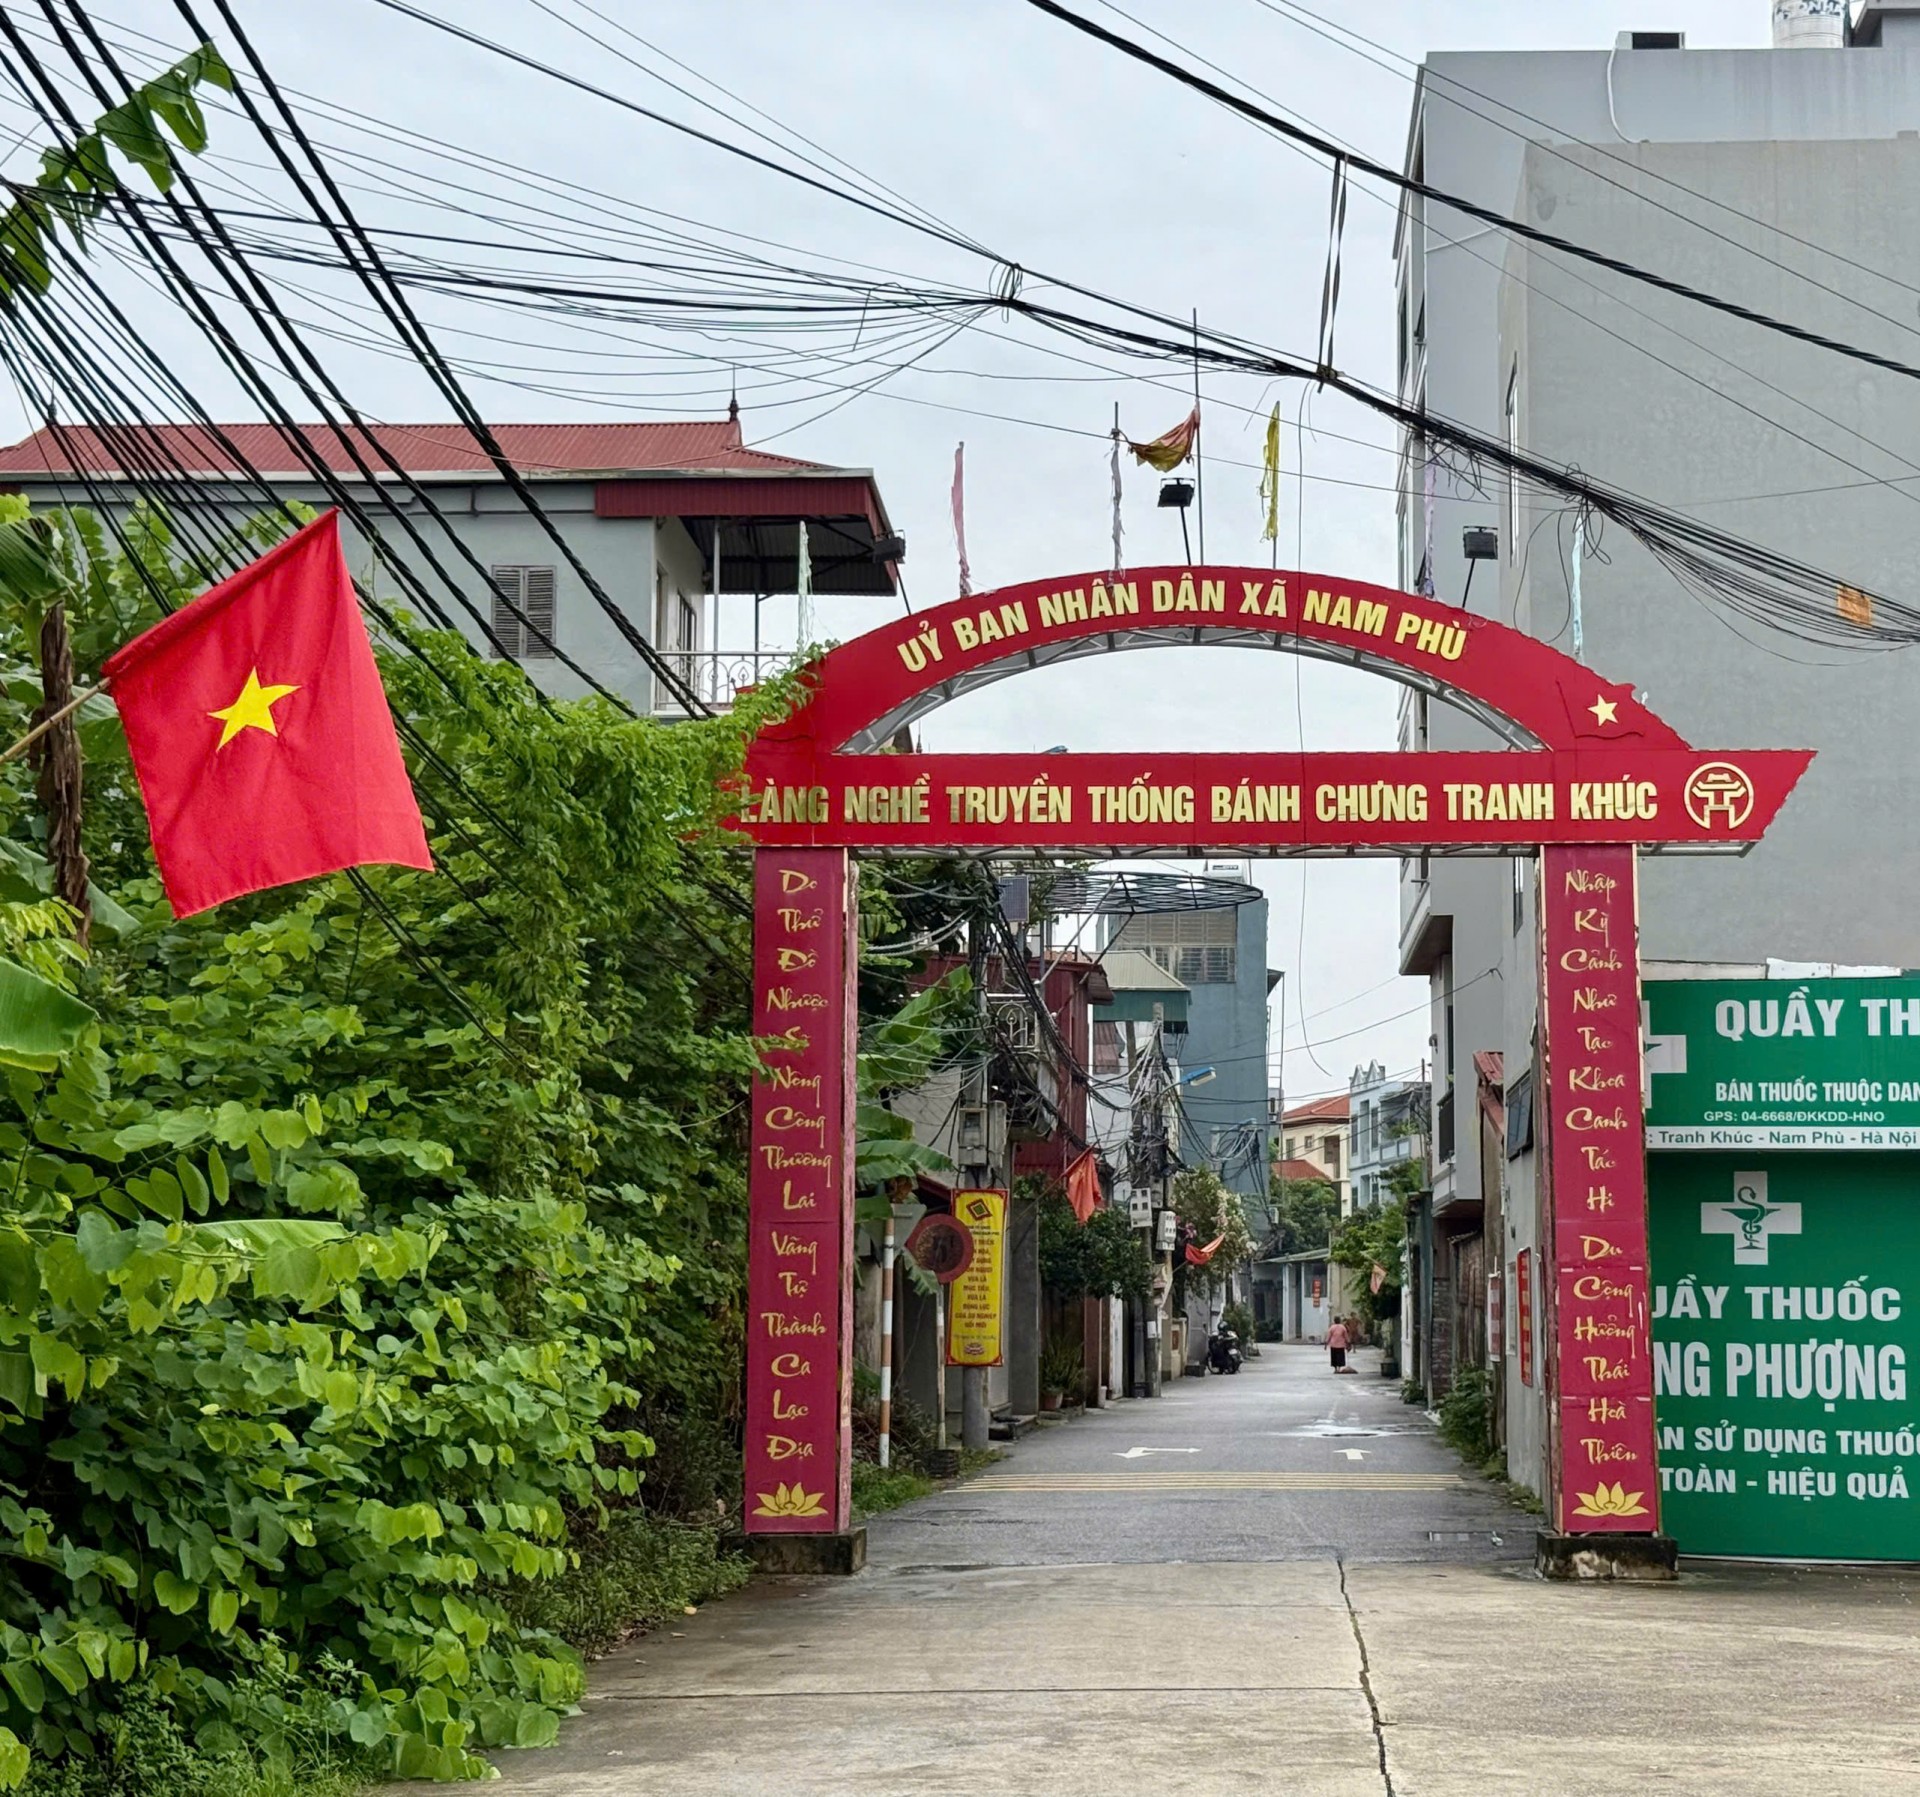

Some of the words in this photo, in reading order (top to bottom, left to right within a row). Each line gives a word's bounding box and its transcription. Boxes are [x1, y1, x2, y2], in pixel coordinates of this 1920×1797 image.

[898, 619, 944, 673] UỶ
[952, 600, 1029, 652] BAN
[1037, 581, 1140, 629] NHÂN
[1151, 574, 1227, 614] DÂN
[1238, 579, 1288, 619] XÃ
[1303, 590, 1389, 635] NAM
[1394, 612, 1468, 662] PHÙ
[843, 772, 931, 824] NGHỀ
[945, 771, 1073, 825] TRUYỀN
[1088, 771, 1195, 825] THỐNG
[1210, 776, 1301, 824] BÁNH
[1314, 780, 1429, 824] CHƯNG
[1442, 782, 1555, 822] TRANH
[1569, 773, 1659, 821] KHÚC
[1564, 869, 1617, 903] Nhập
[1715, 985, 1845, 1042] QUẦY
[1860, 997, 1920, 1039] TH
[1569, 1066, 1625, 1092] Khoa
[1716, 1077, 1754, 1103] BÁN
[1758, 1075, 1817, 1103] THUỐC
[1822, 1078, 1882, 1106] THUỘC
[765, 1106, 826, 1149] Công
[1565, 1106, 1628, 1131] Canh
[1703, 1110, 1738, 1122] GPS:
[1659, 1131, 1705, 1144] Tranh
[1710, 1131, 1753, 1144] Khúc
[1769, 1131, 1806, 1144] Nam
[1812, 1131, 1844, 1144] Phù
[1861, 1130, 1883, 1144] Hà
[1889, 1130, 1917, 1147] Nội
[1581, 1146, 1616, 1171] Tác
[783, 1180, 817, 1210] Lai
[1587, 1186, 1615, 1213] Hi
[1579, 1235, 1624, 1260] Du
[1744, 1274, 1902, 1322] THUỐC
[760, 1312, 826, 1338] Thành
[770, 1353, 811, 1378] Ca
[1583, 1356, 1631, 1383] Thái
[1726, 1338, 1907, 1413] PHƯỢNG
[773, 1389, 809, 1420] Lạc
[1589, 1396, 1627, 1424] Hoà
[766, 1434, 815, 1461] Địa
[1580, 1438, 1638, 1465] Thiên
[1694, 1418, 1737, 1452] SỬ
[1744, 1427, 1827, 1459] DỤNG
[1836, 1422, 1920, 1456] THUỐ
[1767, 1466, 1836, 1502] HIỆU
[1846, 1464, 1910, 1500] QUẢ
